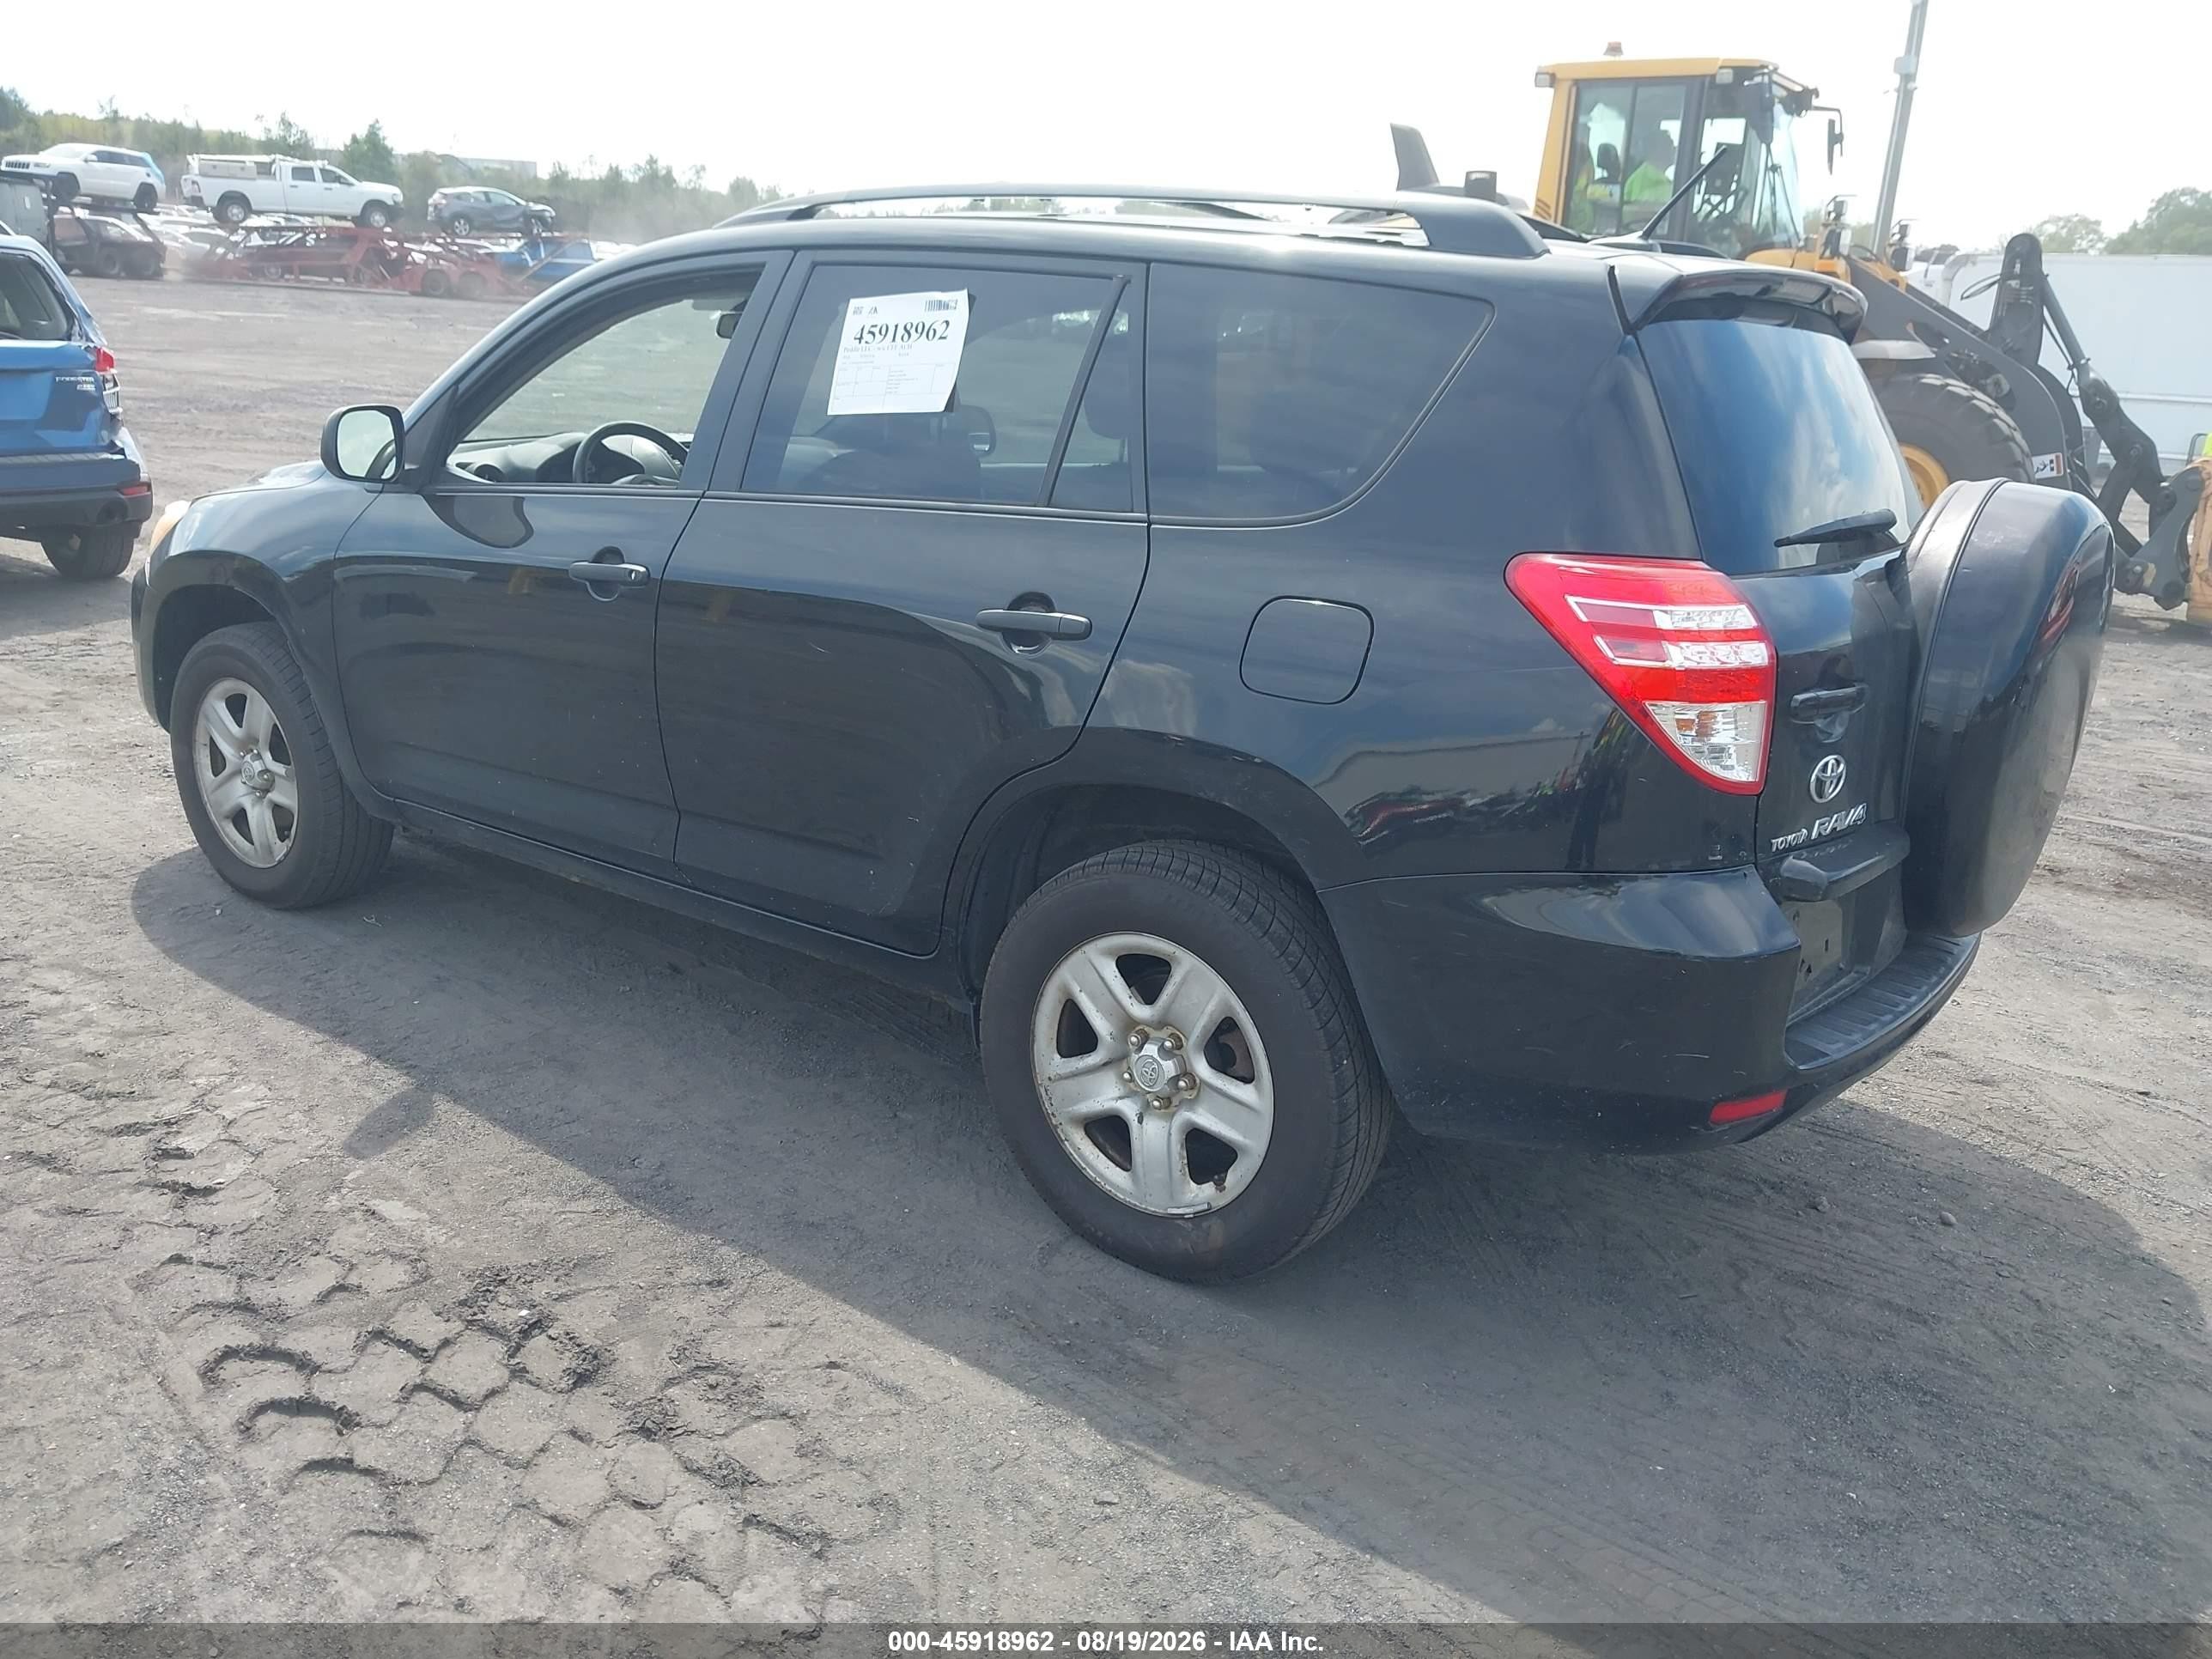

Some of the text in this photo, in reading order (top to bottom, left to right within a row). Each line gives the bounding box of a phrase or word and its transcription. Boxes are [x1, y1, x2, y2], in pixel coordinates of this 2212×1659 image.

[854, 319, 950, 344] 45918962
[1771, 803, 1868, 852] TOYOTA RAV4
